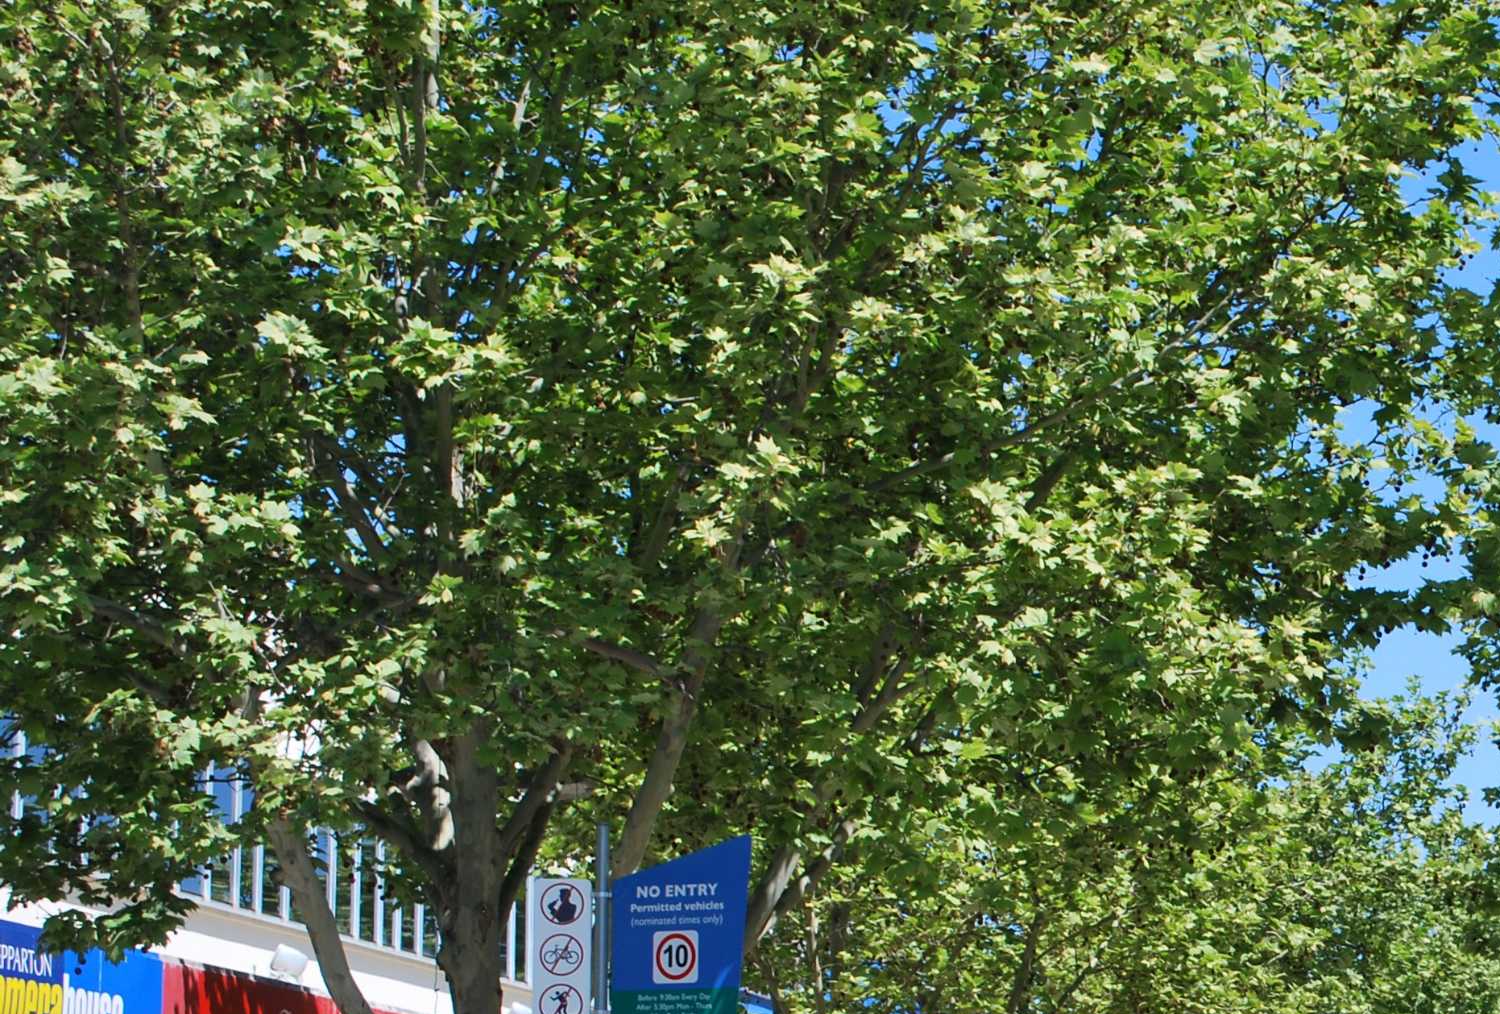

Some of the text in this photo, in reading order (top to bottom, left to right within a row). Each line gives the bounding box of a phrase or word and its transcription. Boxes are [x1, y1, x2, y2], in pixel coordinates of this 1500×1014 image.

[636, 883, 718, 899] NO ENTRY
[630, 900, 724, 912] Permitted vehicles
[630, 914, 724, 928] (nominated times only)
[663, 944, 689, 968] 10
